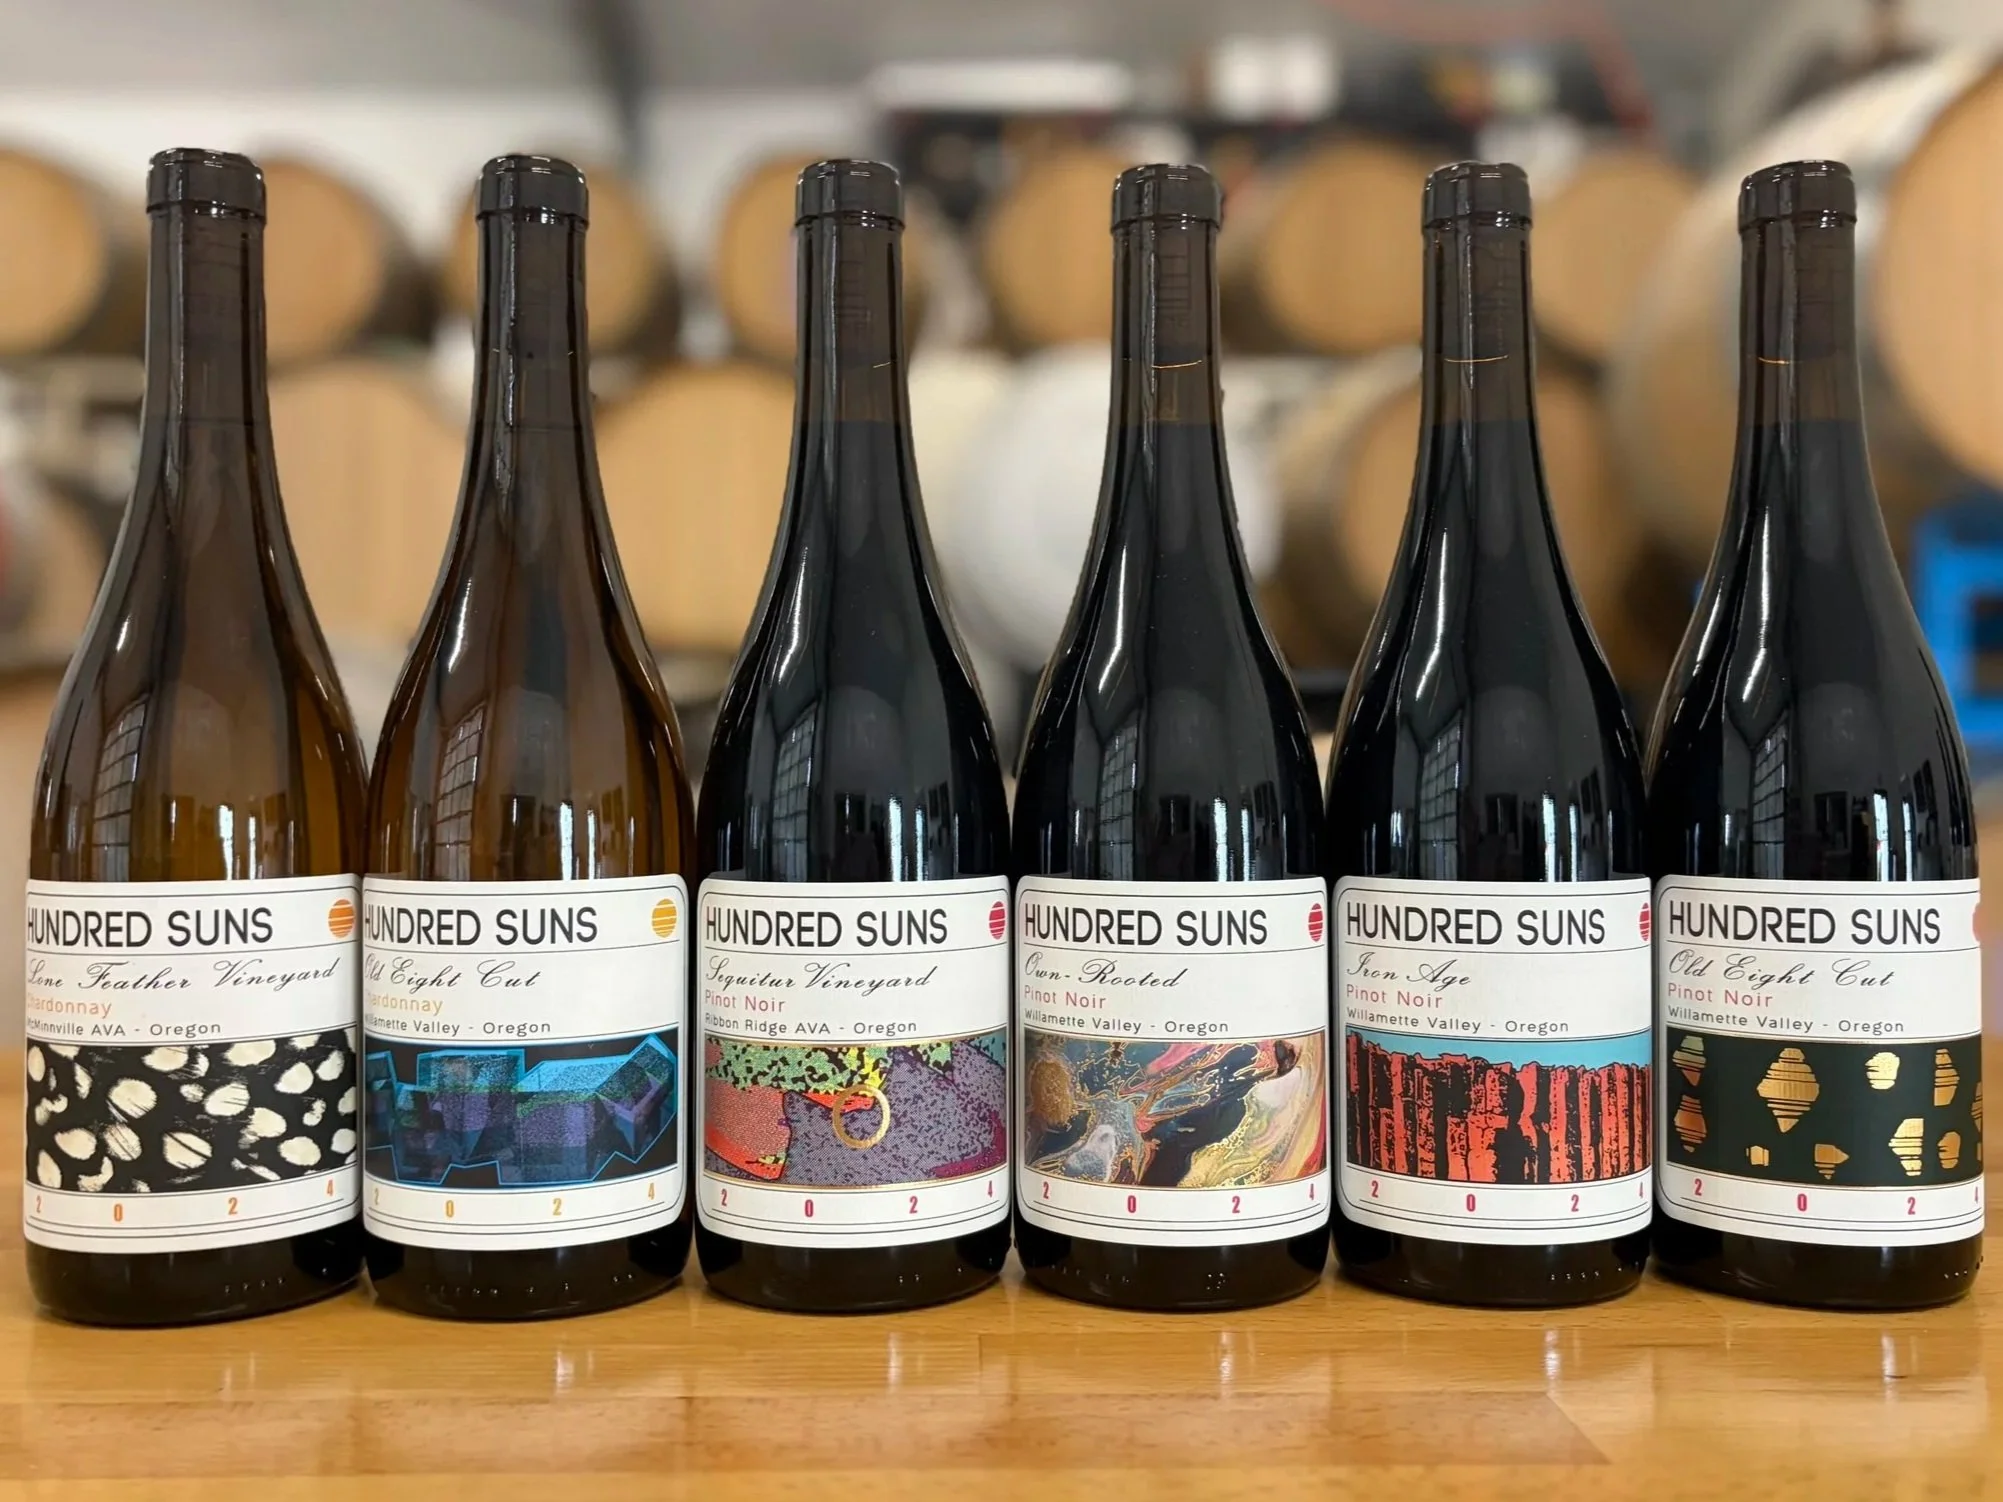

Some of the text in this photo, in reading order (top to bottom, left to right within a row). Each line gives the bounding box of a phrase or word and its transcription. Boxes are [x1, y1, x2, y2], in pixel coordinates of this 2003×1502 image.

[27, 906, 274, 948] HUNDRED SUNS
[365, 903, 598, 946] HUNDRED SUNS
[706, 905, 948, 948] HUNDRED SUNS
[1025, 903, 1268, 947] HUNDRED SUNS
[1347, 902, 1606, 946] HUNDRED SUNS
[1669, 900, 1941, 946] HUNDRED SUNS
[27, 957, 340, 992] Lone Feather Vineyard
[365, 952, 542, 994] Old Eight Cut
[705, 954, 938, 998] Sequitur Vineyard
[1346, 951, 1471, 992] Iron Age
[1668, 948, 1894, 991] Old Eight Cut
[27, 991, 112, 1019] ardonnay
[365, 989, 443, 1016] ardonnay
[705, 989, 786, 1013] Pinot Noir
[1024, 984, 1106, 1010] Pinot Noir
[1346, 982, 1444, 1010] Pinot Noir
[1668, 981, 1773, 1008] Pinot Noir
[91, 1023, 126, 1036] AVA
[150, 1021, 221, 1039] Oregon
[365, 1015, 408, 1033] amette
[413, 1019, 460, 1037] Valley
[483, 1021, 551, 1037] Oregon
[705, 1012, 740, 1030] Ribbon
[745, 1018, 787, 1036] Ridge
[795, 1022, 831, 1035] AVA
[853, 1021, 917, 1035] Oregon
[1024, 1008, 1085, 1029] Willamette
[1092, 1017, 1142, 1035] Valley
[1164, 1020, 1228, 1036] Oregon
[1346, 1006, 1419, 1029] Willamette
[1427, 1016, 1481, 1034] Valley
[1504, 1019, 1569, 1036] Oregon
[1668, 1004, 1748, 1028] Willamette
[1757, 1015, 1814, 1034] Valley
[1838, 1019, 1904, 1036] Oregon
[36, 1180, 334, 1221] 2 0 2 4
[374, 1183, 655, 1217] 2 0 2 4
[722, 1180, 993, 1217] 2 0 2 4
[1043, 1181, 1314, 1213] 2 0 2 4
[1372, 1181, 1378, 1198] 2
[1467, 1194, 1475, 1212] 0
[1572, 1195, 1579, 1212] 2
[1695, 1179, 1702, 1196] 2
[1798, 1194, 1807, 1211] 0
[1908, 1197, 1915, 1215] 2
